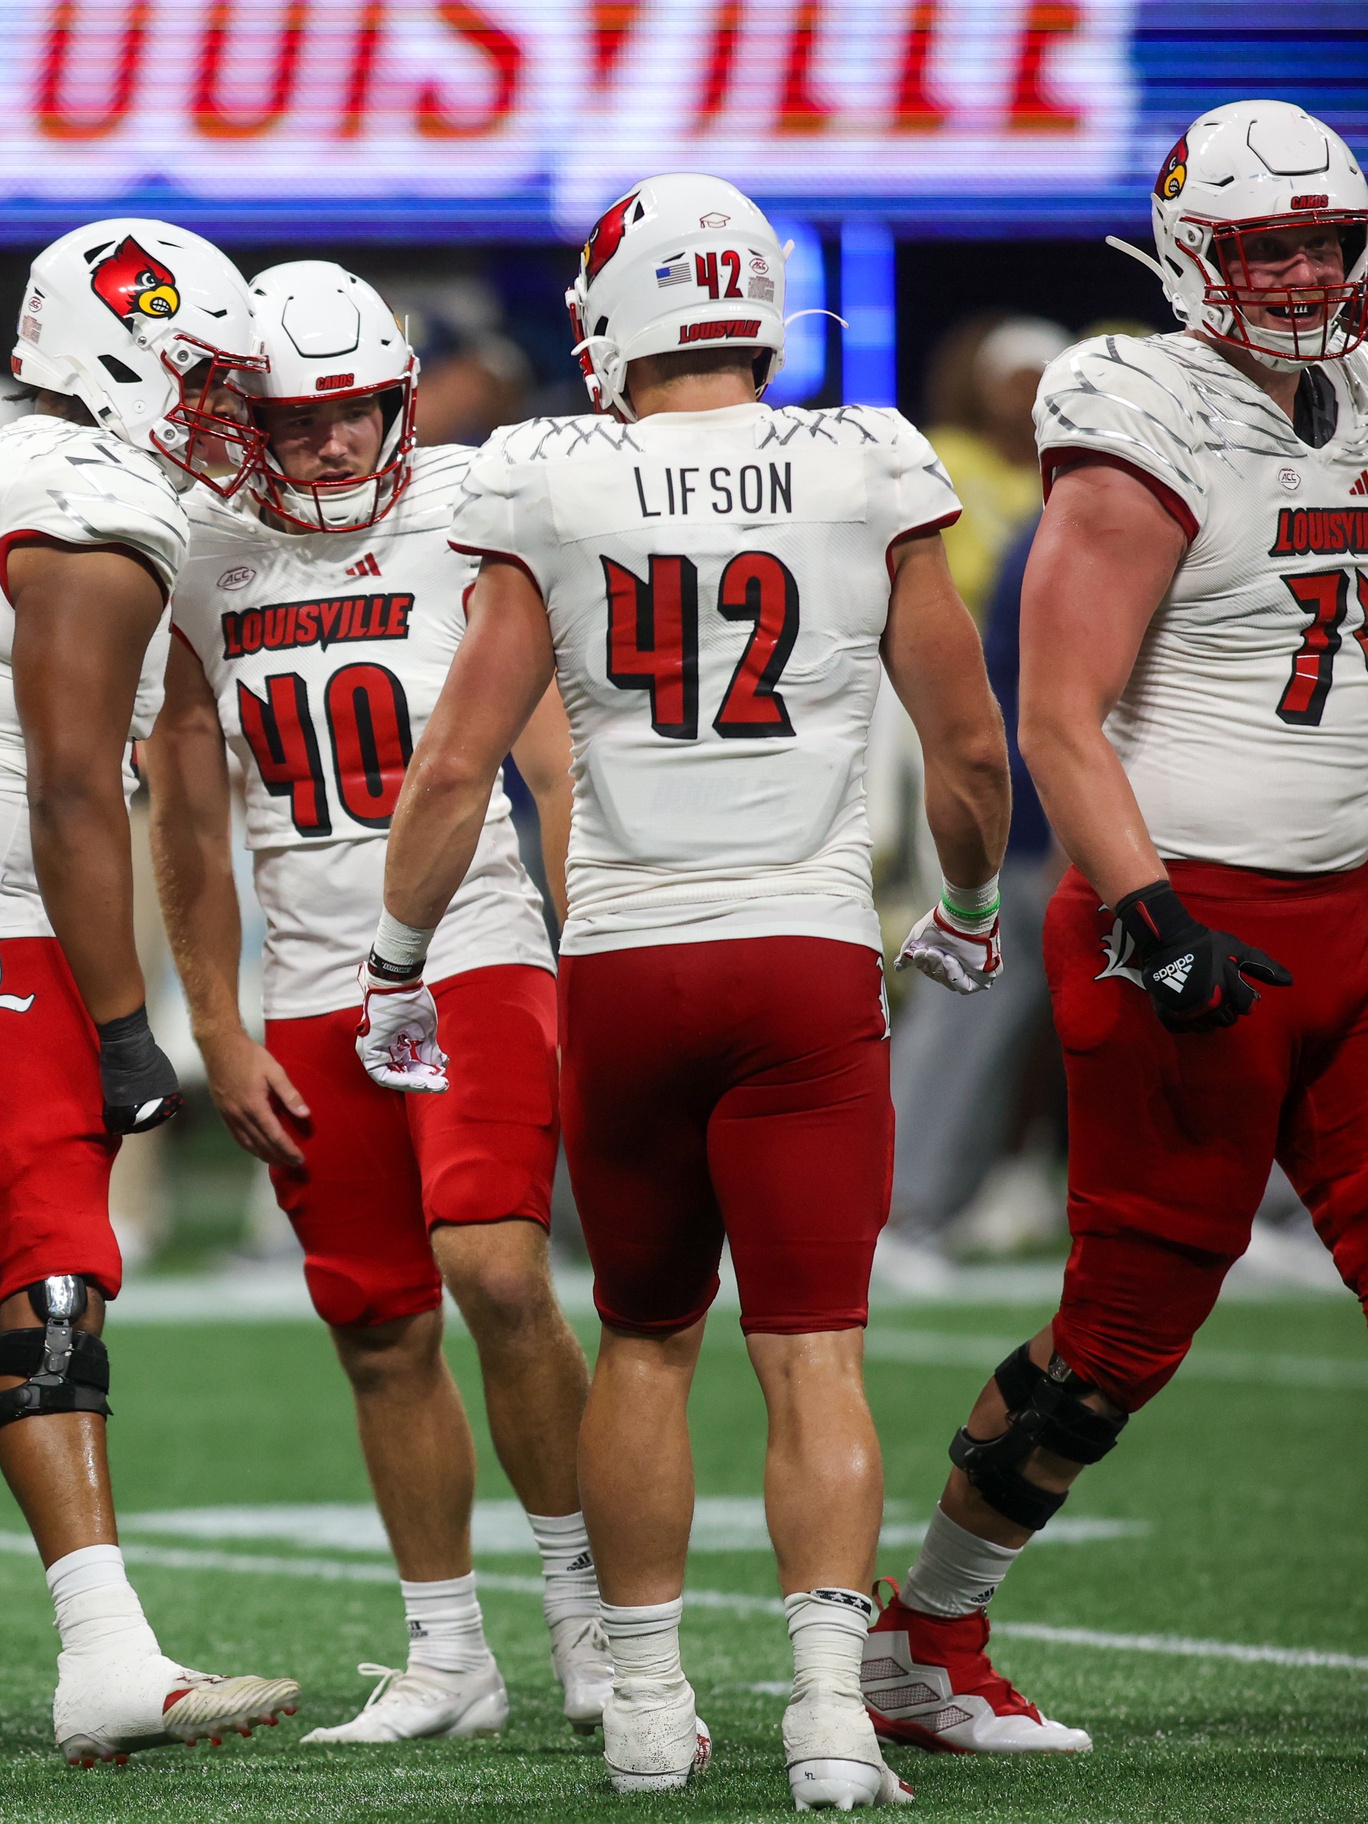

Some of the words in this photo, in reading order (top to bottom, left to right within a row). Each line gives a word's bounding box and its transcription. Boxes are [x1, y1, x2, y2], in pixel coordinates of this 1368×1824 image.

[1291, 195, 1329, 210] CARDS
[694, 250, 744, 300] 42
[677, 320, 762, 345] LOUISVILLE
[316, 373, 354, 391] CARDS
[633, 462, 792, 517] LIFSON
[1268, 507, 1368, 558] LOUISVI
[221, 592, 415, 660] LOUISVILLE
[599, 551, 800, 739] 42
[1275, 567, 1368, 726] 7
[236, 662, 413, 837] 40
[1152, 953, 1195, 982] adidas
[804, 1771, 816, 1780] 42
